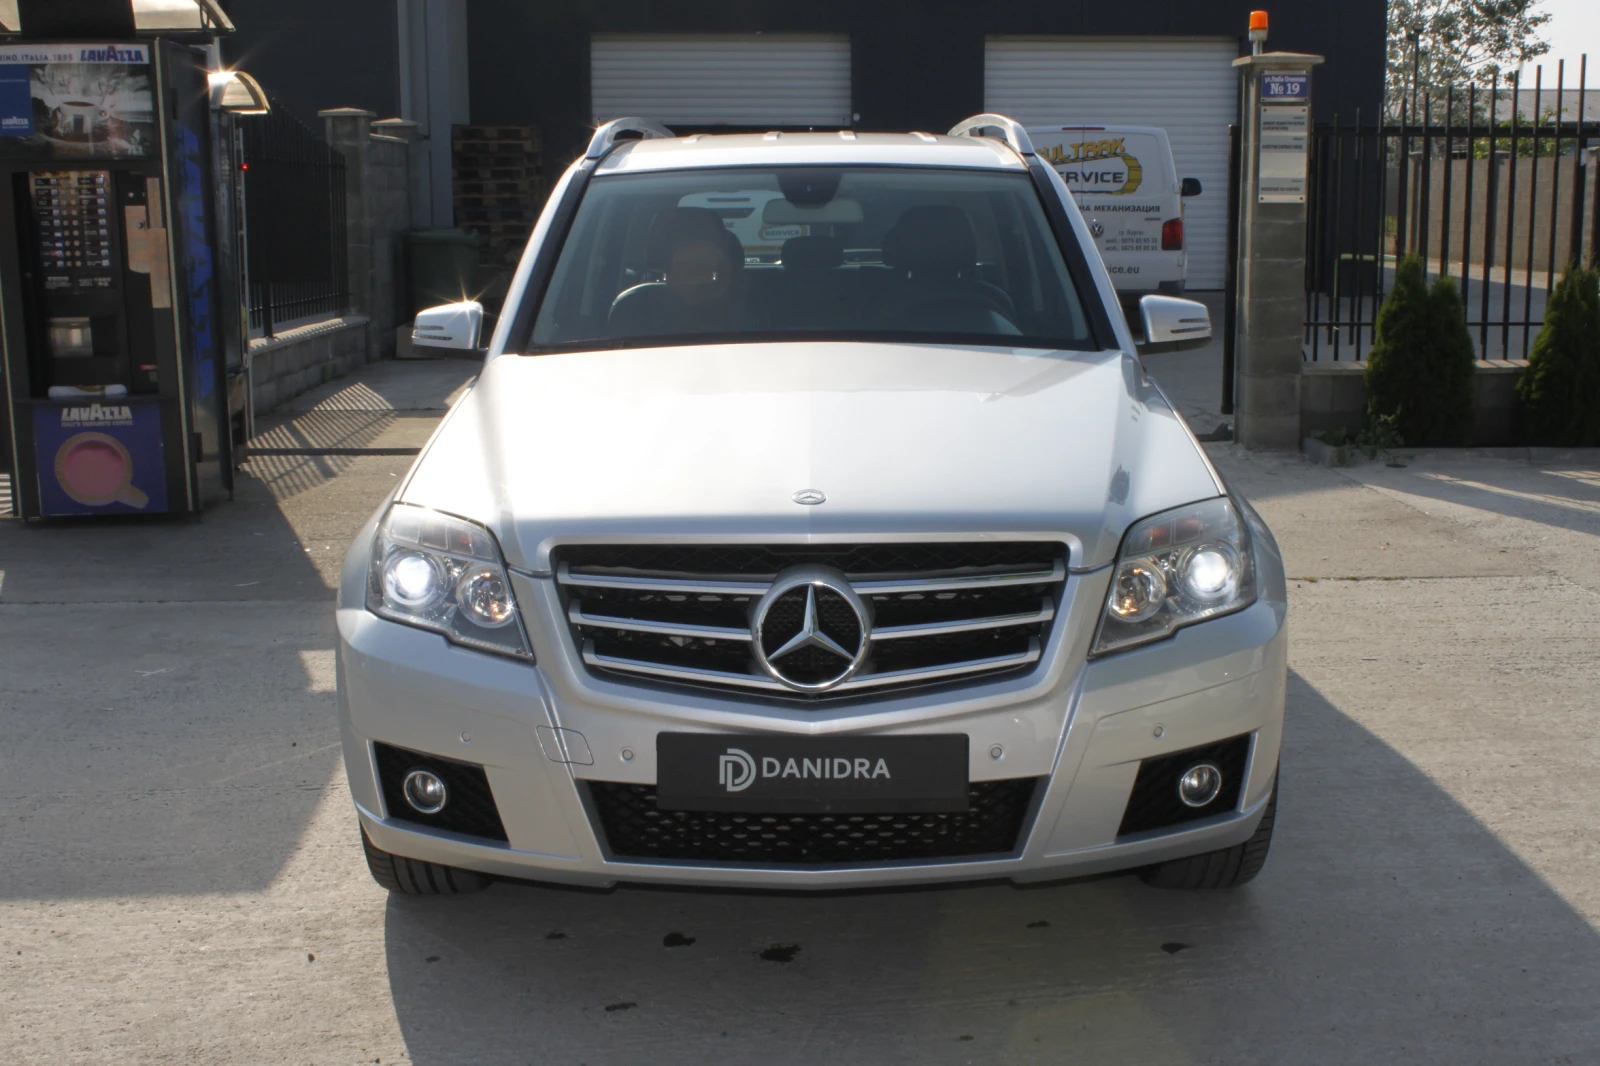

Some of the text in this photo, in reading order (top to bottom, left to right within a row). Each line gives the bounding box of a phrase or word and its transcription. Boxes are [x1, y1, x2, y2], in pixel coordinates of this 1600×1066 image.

[80, 45, 143, 62] LAVAZZA
[1286, 83, 1301, 95] 19
[1094, 205, 1161, 213] МЕХАНИЗАЦИЯ
[765, 229, 800, 237] SERVICE
[61, 403, 133, 421] LAVAZZA
[762, 757, 891, 779] DANIDRA
